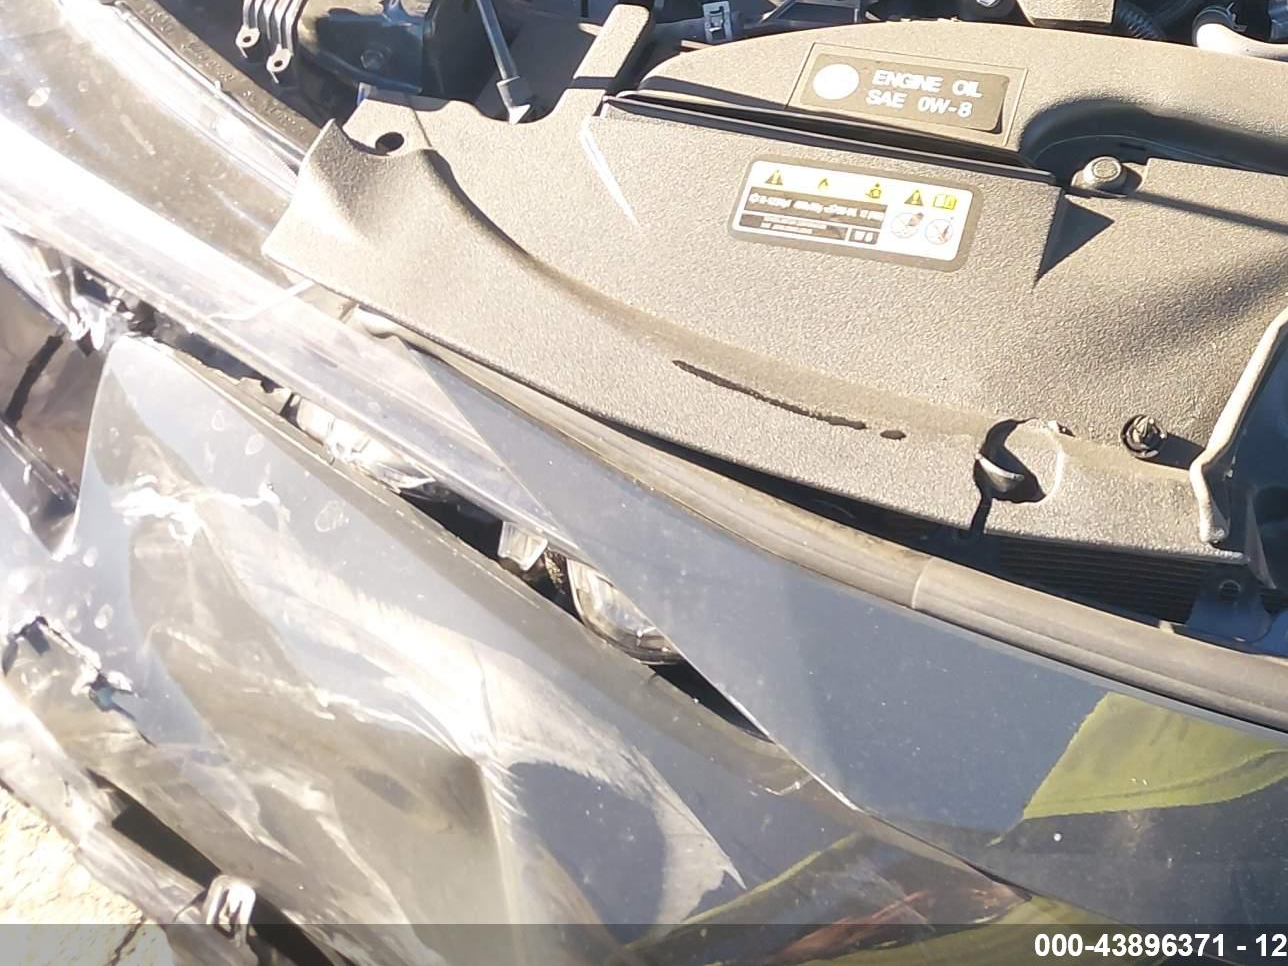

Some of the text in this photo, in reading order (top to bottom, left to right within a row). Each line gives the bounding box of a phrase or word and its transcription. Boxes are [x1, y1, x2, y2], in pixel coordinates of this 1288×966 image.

[873, 69, 982, 98] ENGINE OIL
[867, 90, 973, 118] SAE 0W-8
